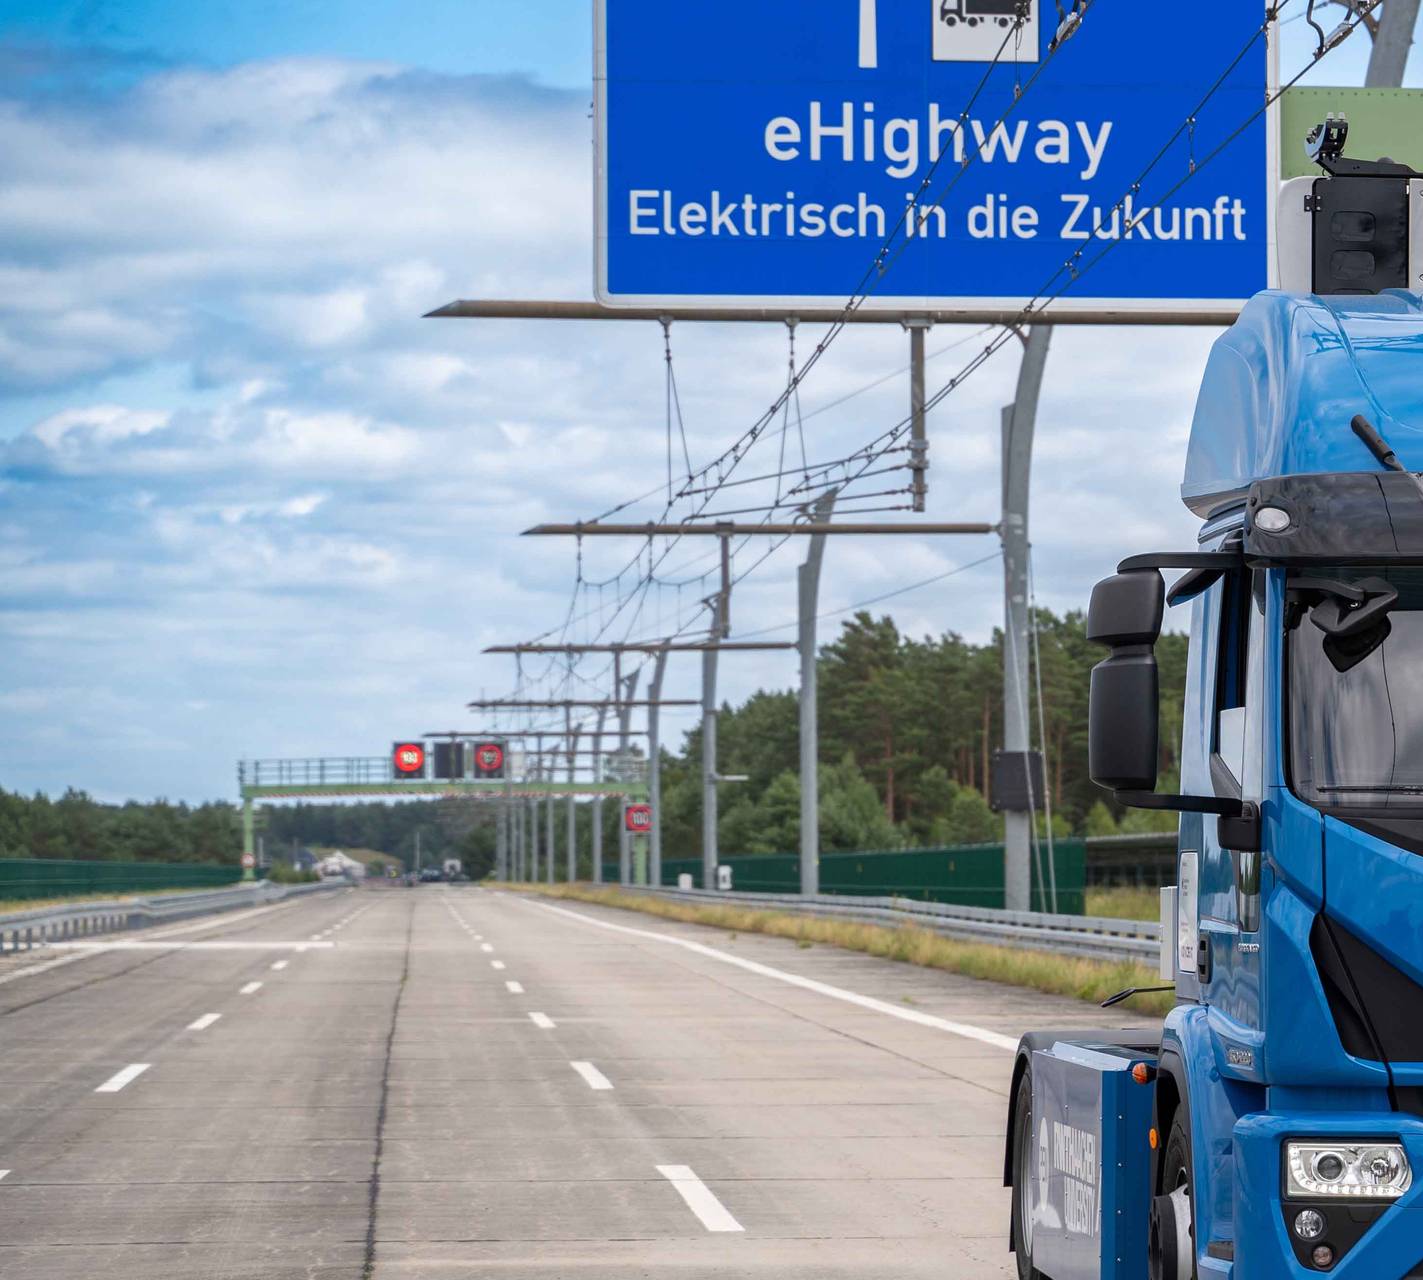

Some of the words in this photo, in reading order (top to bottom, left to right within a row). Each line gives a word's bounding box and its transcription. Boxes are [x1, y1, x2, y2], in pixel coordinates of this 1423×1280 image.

[764, 100, 1113, 181] eHighway
[629, 189, 886, 238] Elektrisch
[905, 192, 946, 239] in
[966, 194, 1039, 240] die
[1060, 194, 1247, 242] Zukunft
